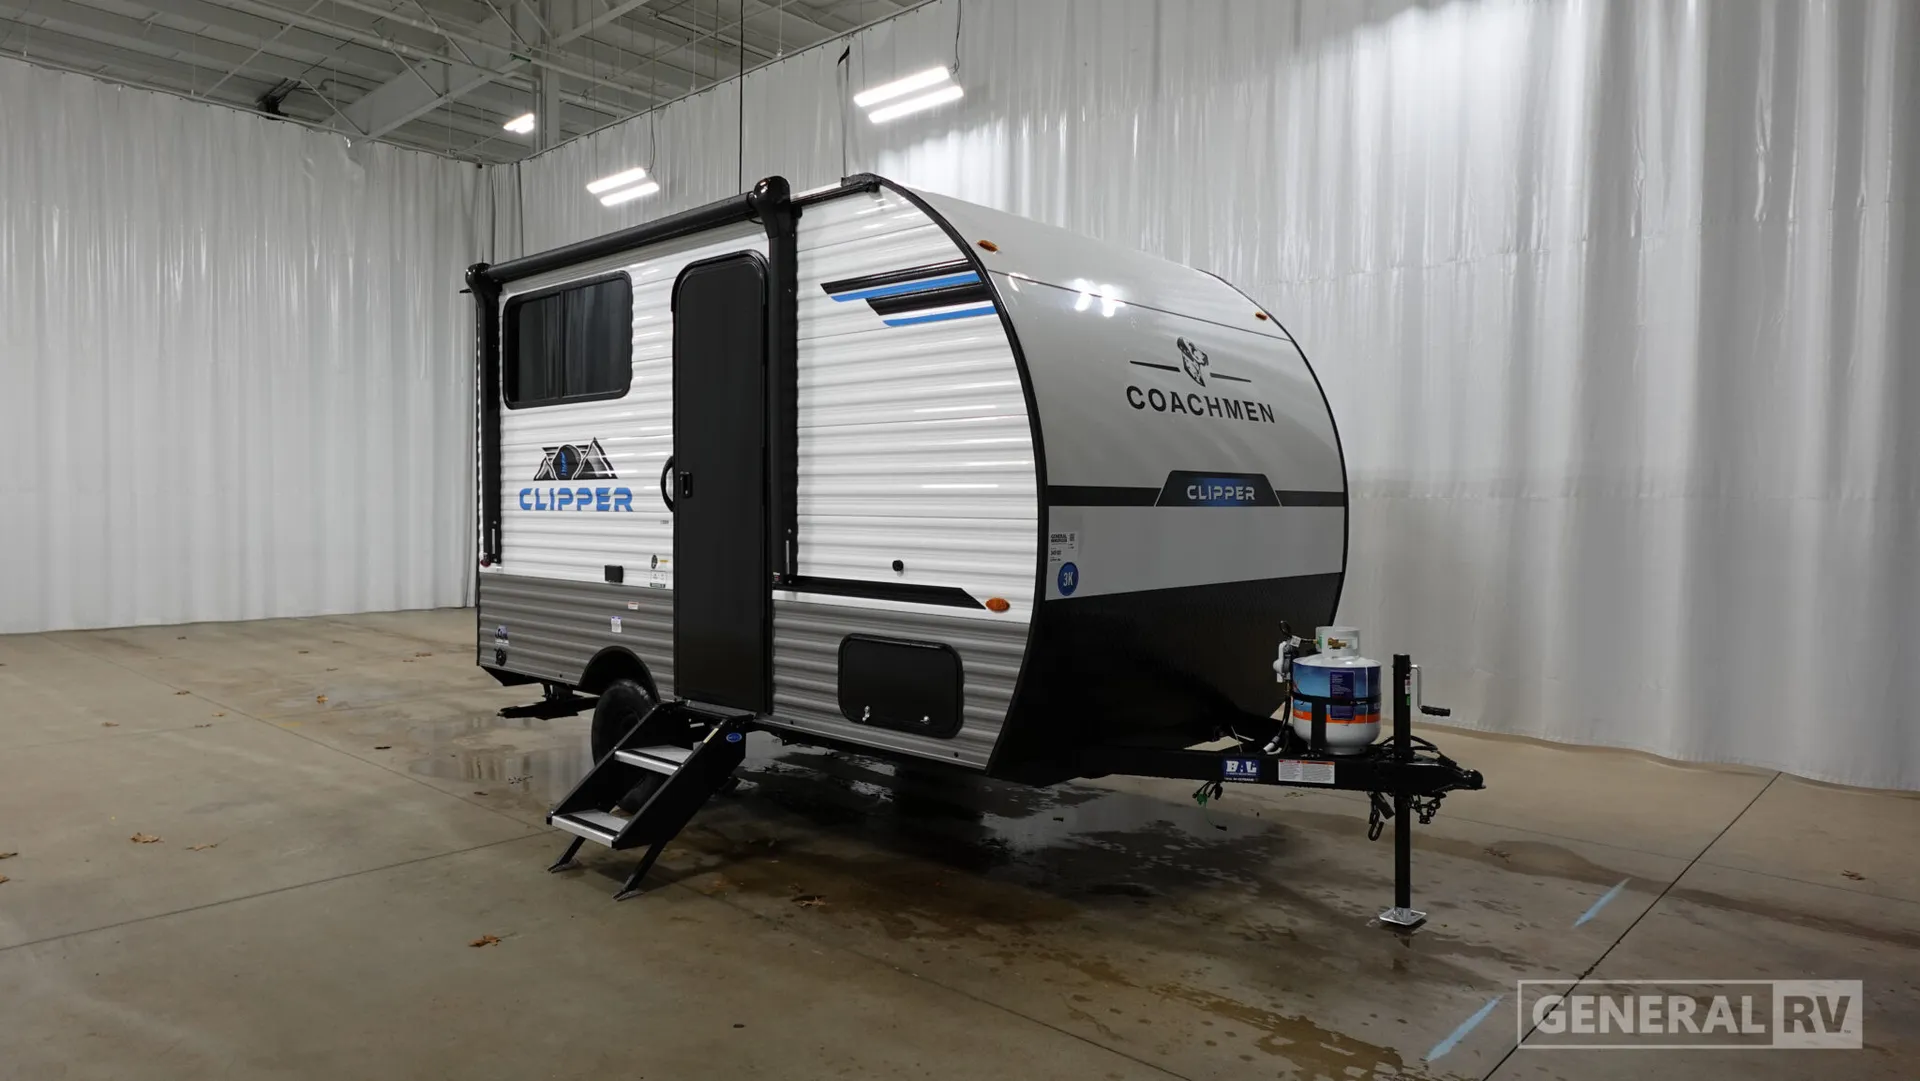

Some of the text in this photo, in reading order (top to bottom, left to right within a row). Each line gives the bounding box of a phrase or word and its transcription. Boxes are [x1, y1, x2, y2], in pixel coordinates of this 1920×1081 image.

[1126, 385, 1275, 424] COACHMEN
[519, 487, 634, 512] CLIPPER
[1186, 485, 1255, 501] CLIPPER
[1063, 572, 1073, 587] 3K
